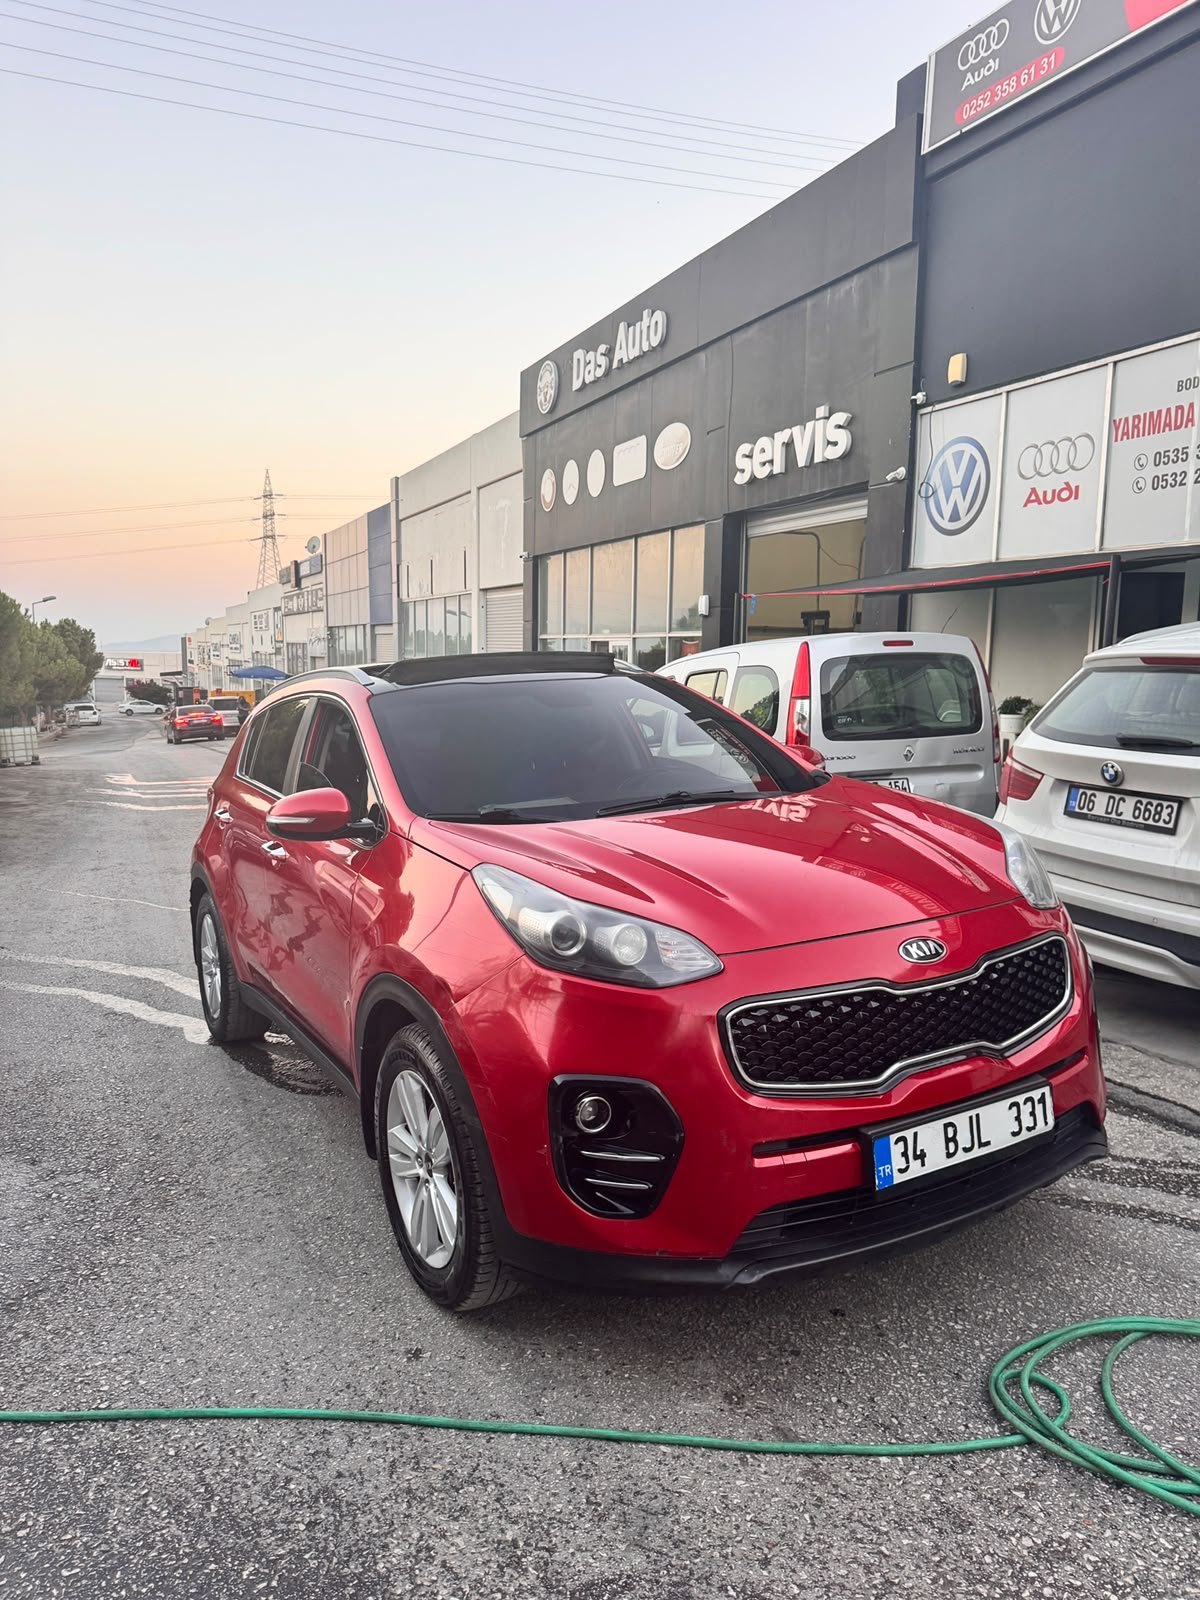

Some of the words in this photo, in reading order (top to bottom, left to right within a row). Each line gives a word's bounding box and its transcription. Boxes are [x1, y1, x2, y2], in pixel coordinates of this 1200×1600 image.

[961, 57, 999, 91] Audi
[962, 90, 991, 120] 0252
[993, 77, 1017, 102] 358
[1020, 66, 1036, 87] 61
[1040, 53, 1056, 75] 31
[571, 343, 610, 392] Das
[612, 308, 667, 369] Auto
[1112, 402, 1196, 443] YARIMADA
[733, 404, 853, 485] servis
[1153, 446, 1189, 468] 0535
[1023, 482, 1080, 507] Audi
[1151, 470, 1188, 491] 0532
[1077, 791, 1097, 812] 06
[1105, 795, 1126, 817] DC
[1132, 797, 1175, 825] 6683
[904, 941, 943, 958] KIA
[878, 1164, 892, 1177] TR
[893, 1132, 927, 1174] 34
[943, 1113, 991, 1159] BJL
[1007, 1092, 1049, 1138] 331
